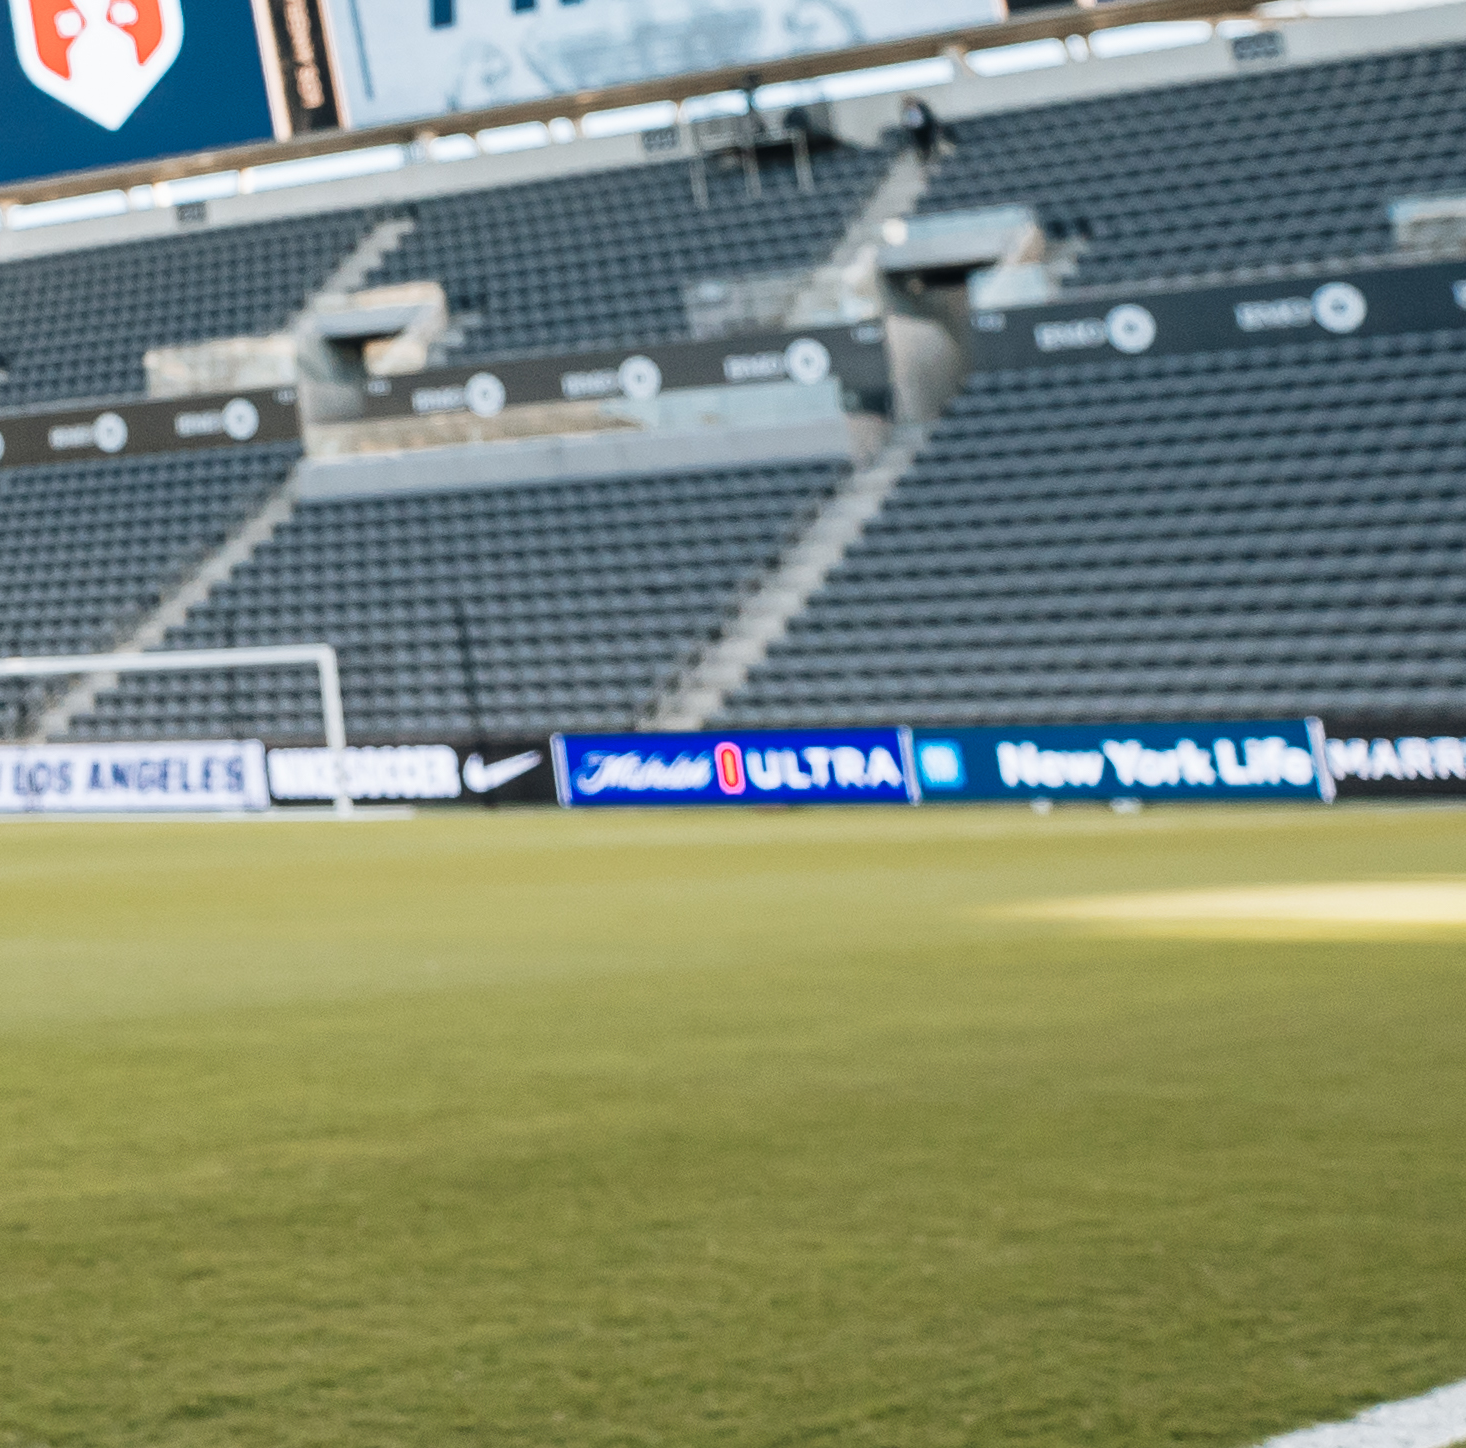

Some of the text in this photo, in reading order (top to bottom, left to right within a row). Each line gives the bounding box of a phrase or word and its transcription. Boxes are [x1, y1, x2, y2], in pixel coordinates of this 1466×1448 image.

[13, 758, 73, 793] LOS
[88, 755, 245, 792] ANGELES
[746, 746, 903, 790] ULTRA
[996, 737, 1315, 787] New York Life
[1324, 736, 1466, 781] MARR
